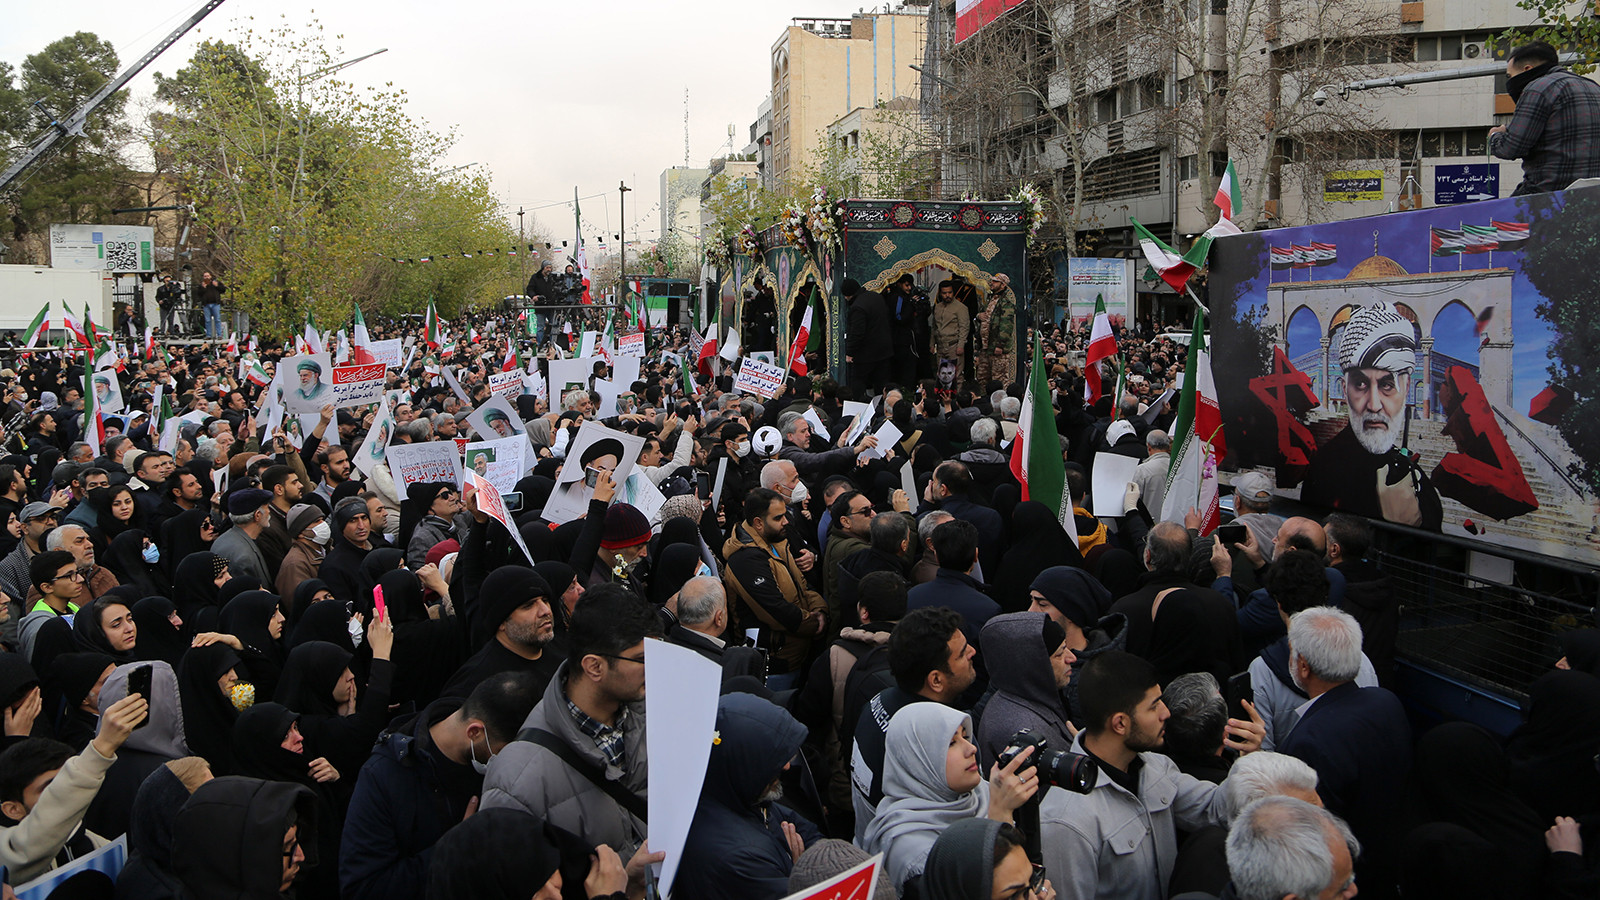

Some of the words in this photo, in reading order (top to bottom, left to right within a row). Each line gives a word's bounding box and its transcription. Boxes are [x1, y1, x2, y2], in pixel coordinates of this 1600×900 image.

[1366, 179, 1378, 188] دفتر
[1484, 175, 1496, 183] دفتر
[1458, 184, 1474, 192] تهران
[744, 360, 763, 370] آمریکا
[513, 372, 521, 380] مرگ
[770, 369, 782, 377] مرگ
[491, 374, 506, 384] آمریکا
[739, 375, 761, 385] اسرائیل
[333, 384, 351, 394] آمریک
[371, 380, 383, 390] شعار
[337, 394, 348, 404] شود
[402, 465, 421, 473] DOWN
[432, 472, 437, 480] بر
[439, 469, 454, 479] مرگ
